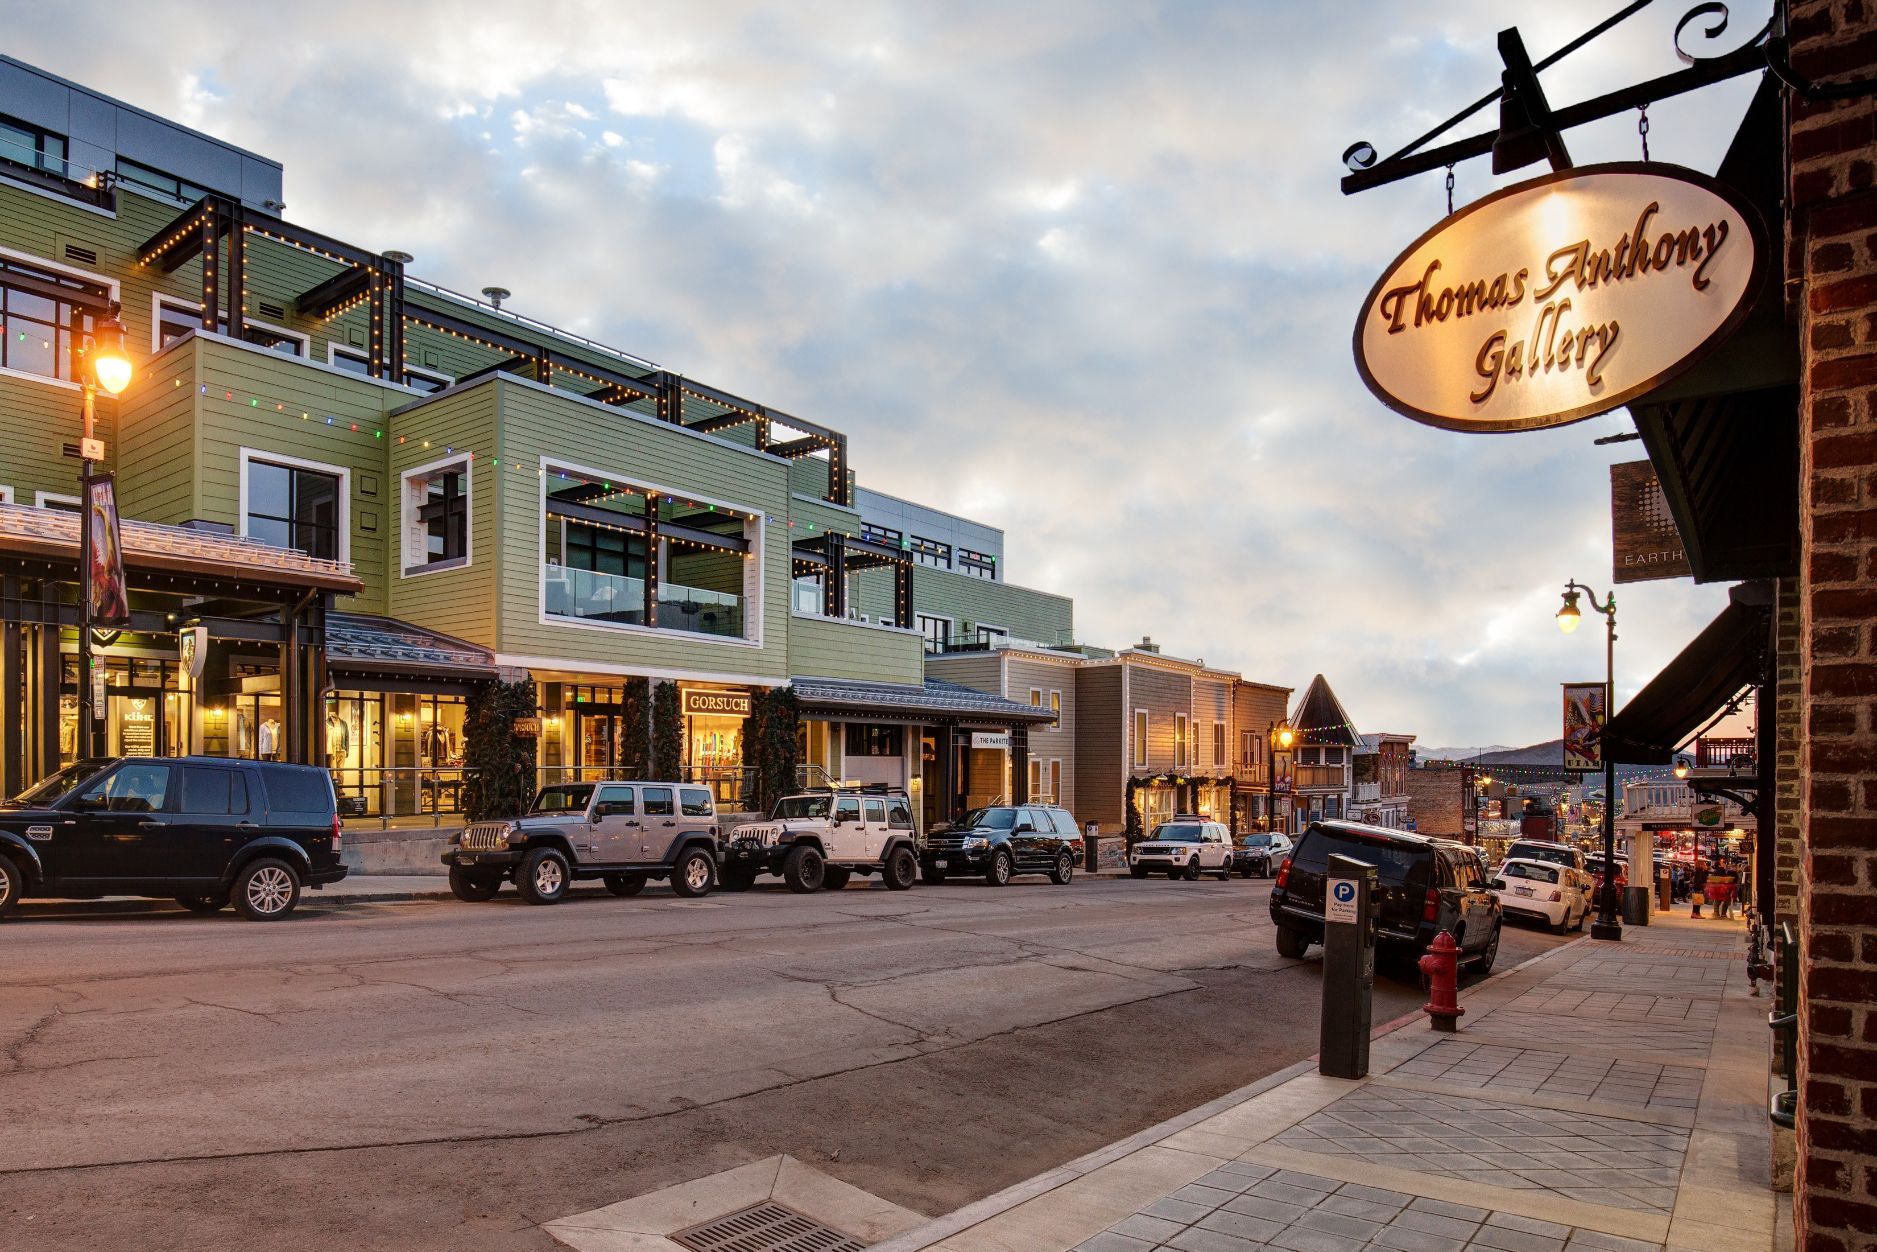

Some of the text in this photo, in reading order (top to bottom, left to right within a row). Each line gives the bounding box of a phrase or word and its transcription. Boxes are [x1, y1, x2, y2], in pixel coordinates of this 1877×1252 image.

[1380, 200, 1730, 335] Thomas Anthony
[1469, 297, 1620, 404] Gallery
[1625, 550, 1683, 566] EARTH
[690, 695, 749, 711] GORSUCH
[990, 737, 1009, 745] PARKITE
[1567, 760, 1600, 768] UTAH
[1339, 885, 1350, 899] P
